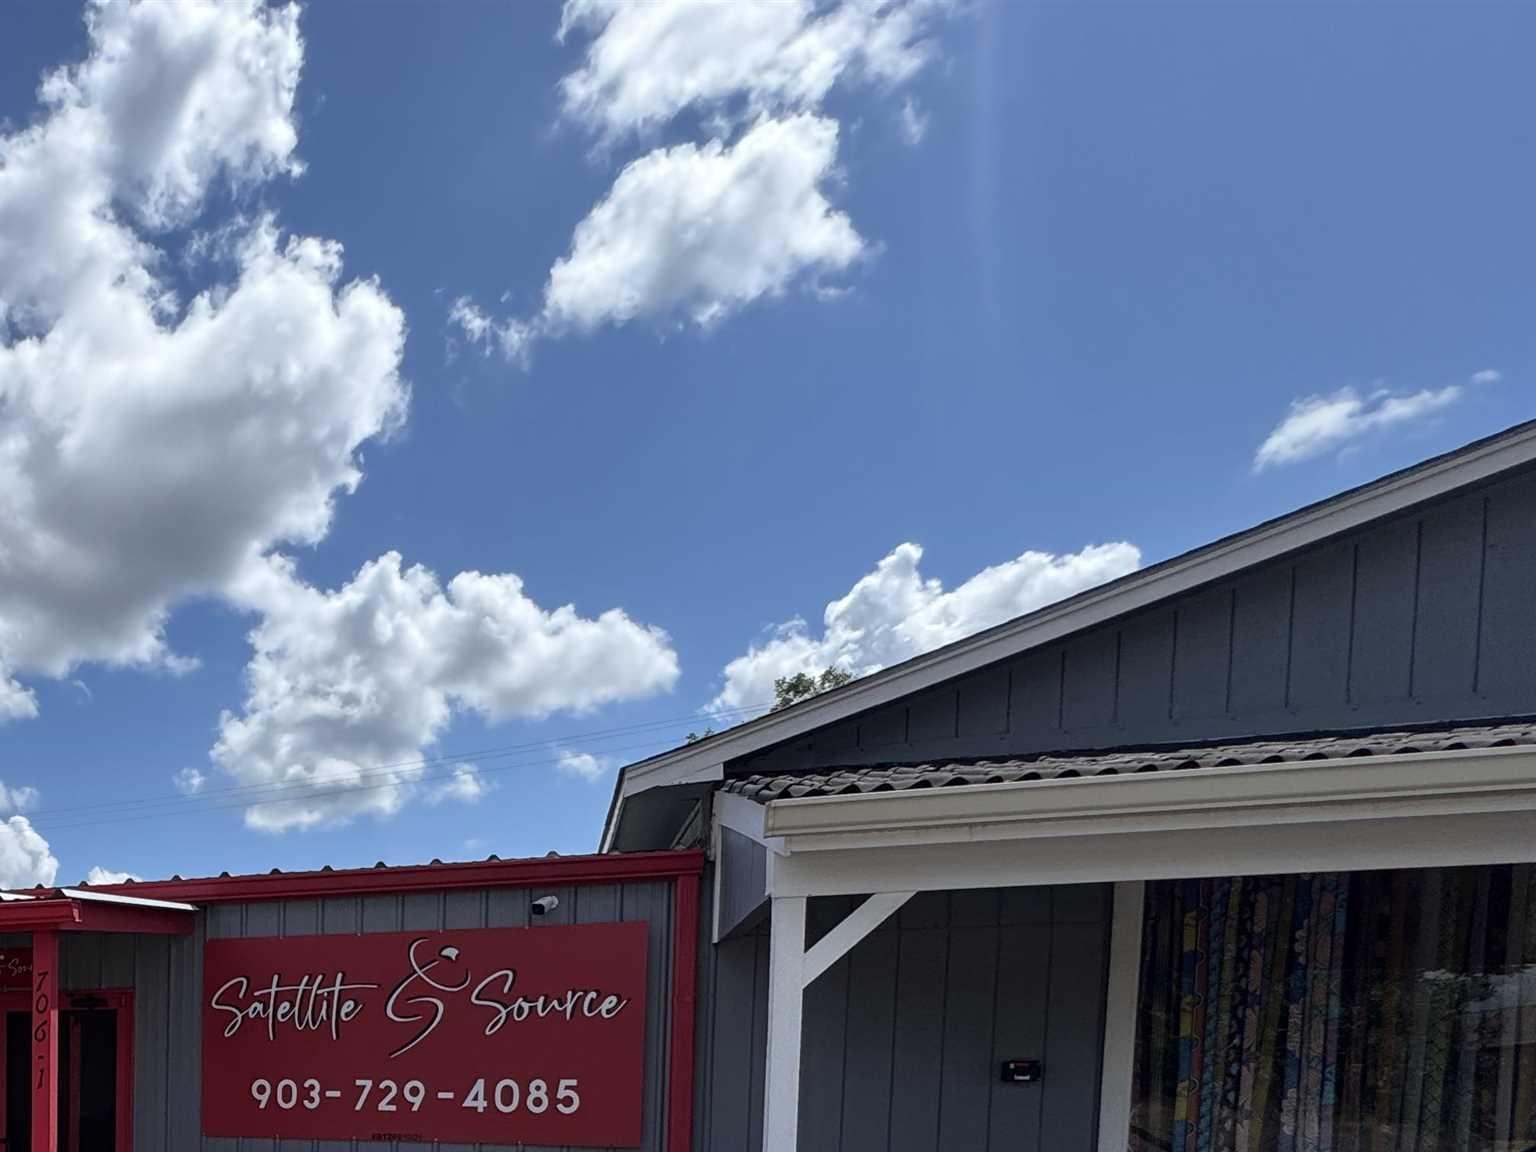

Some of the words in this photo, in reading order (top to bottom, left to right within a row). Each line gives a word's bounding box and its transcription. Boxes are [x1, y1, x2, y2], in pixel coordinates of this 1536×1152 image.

[211, 971, 378, 1040] Satellite
[470, 969, 628, 1036] Source
[251, 1078, 580, 1114] 903-729-4085
